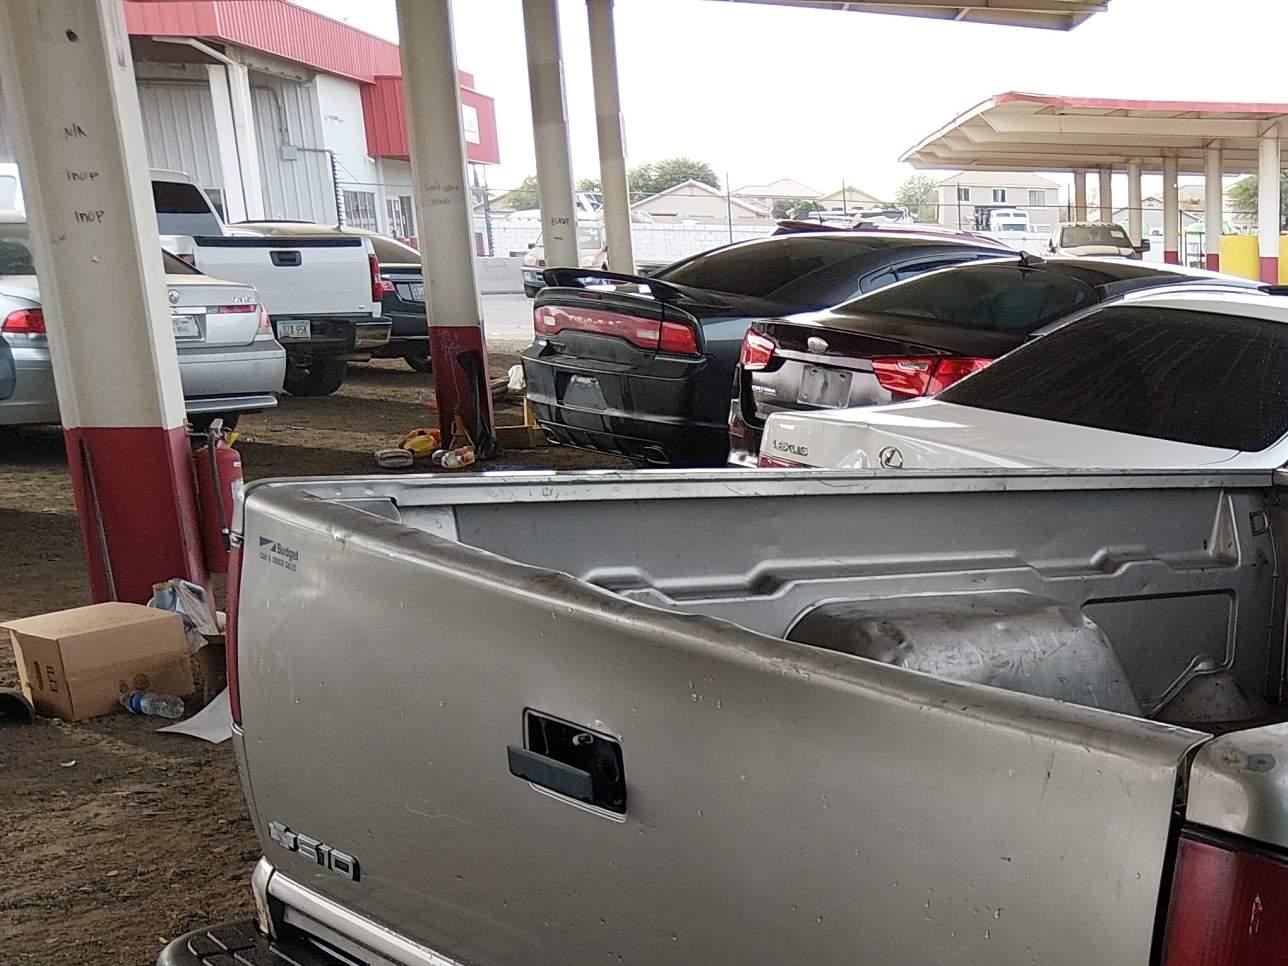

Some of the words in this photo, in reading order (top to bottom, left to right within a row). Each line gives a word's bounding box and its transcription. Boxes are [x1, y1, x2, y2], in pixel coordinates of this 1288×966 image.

[773, 439, 808, 457] LEXUS
[276, 542, 299, 562] Budget
[297, 833, 360, 882] S10
